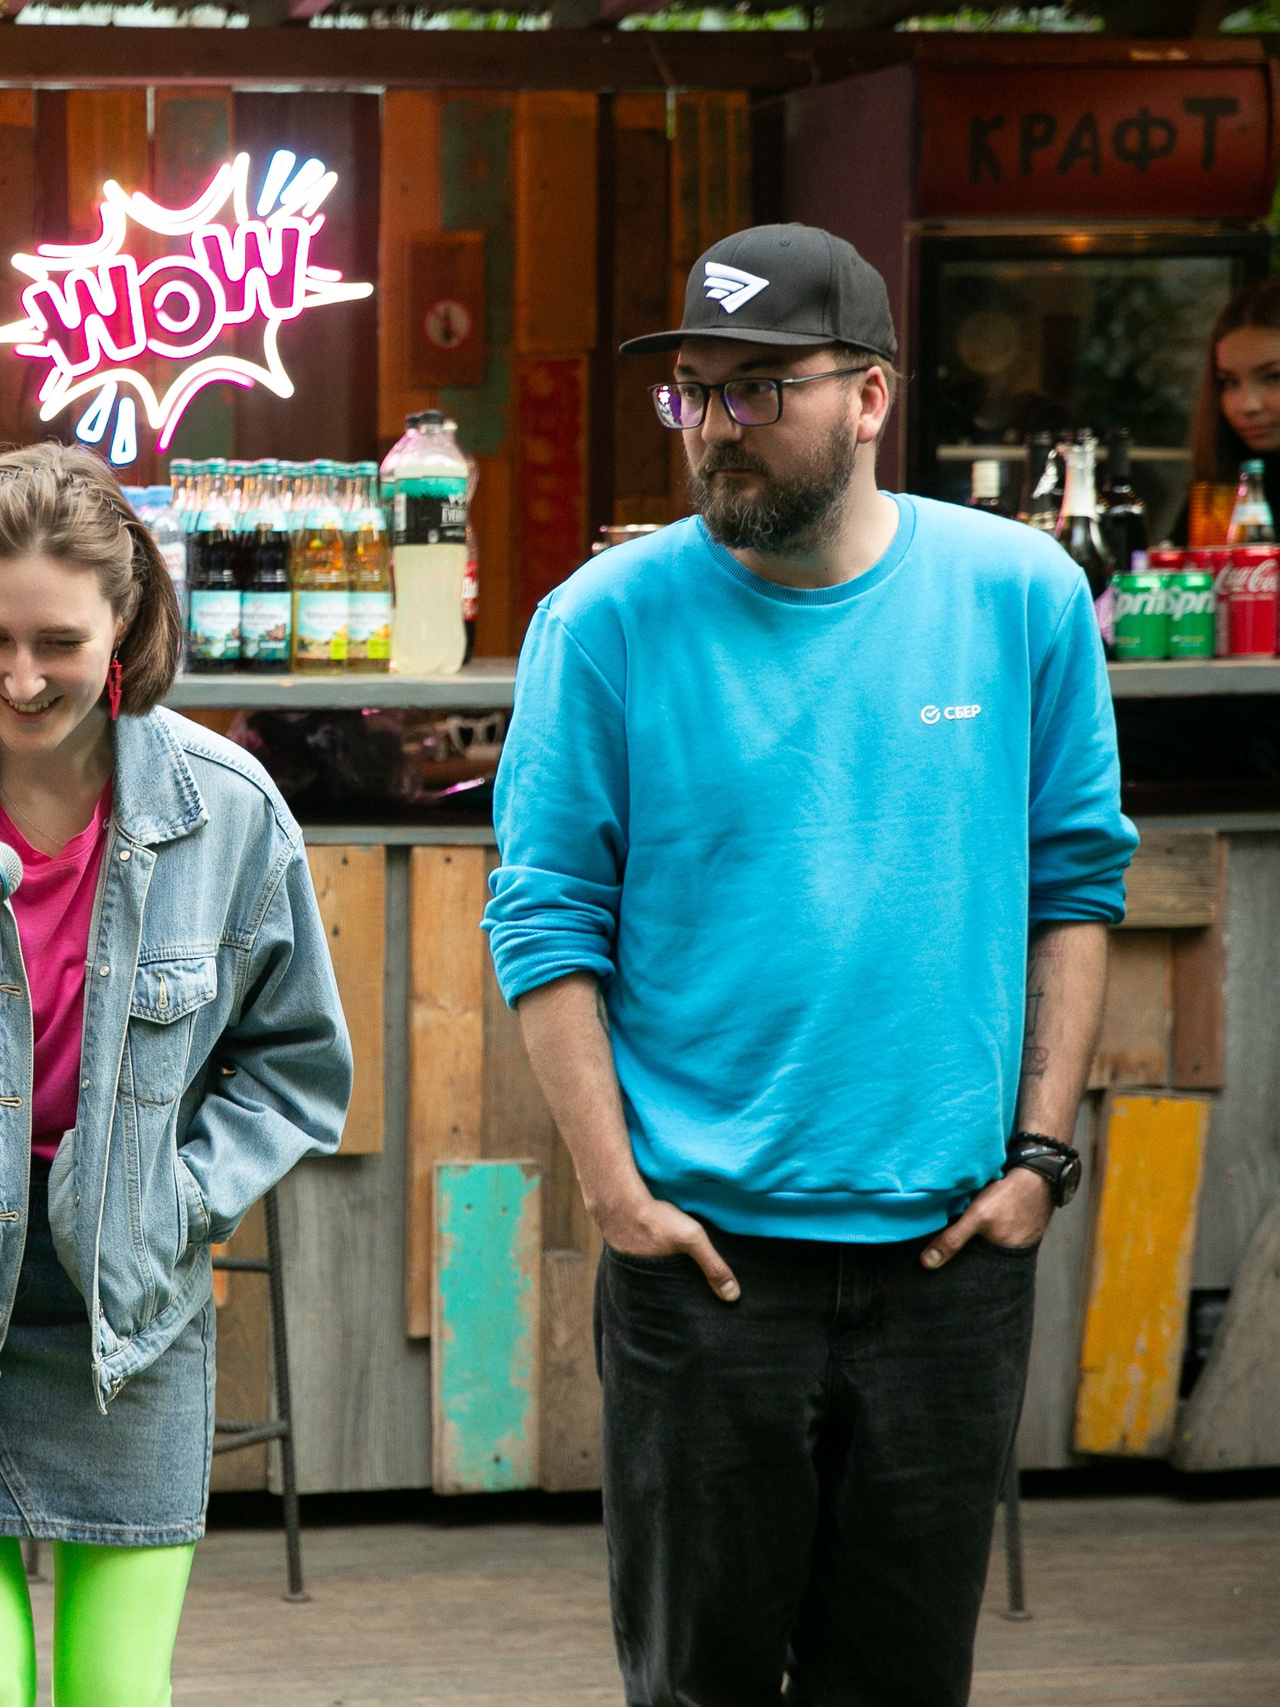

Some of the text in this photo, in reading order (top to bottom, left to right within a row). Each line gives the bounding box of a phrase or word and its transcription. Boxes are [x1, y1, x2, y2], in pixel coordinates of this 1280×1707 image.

[969, 95, 1240, 187] КРАФТ
[21, 216, 314, 377] WOW
[943, 704, 982, 721] СБЕР
